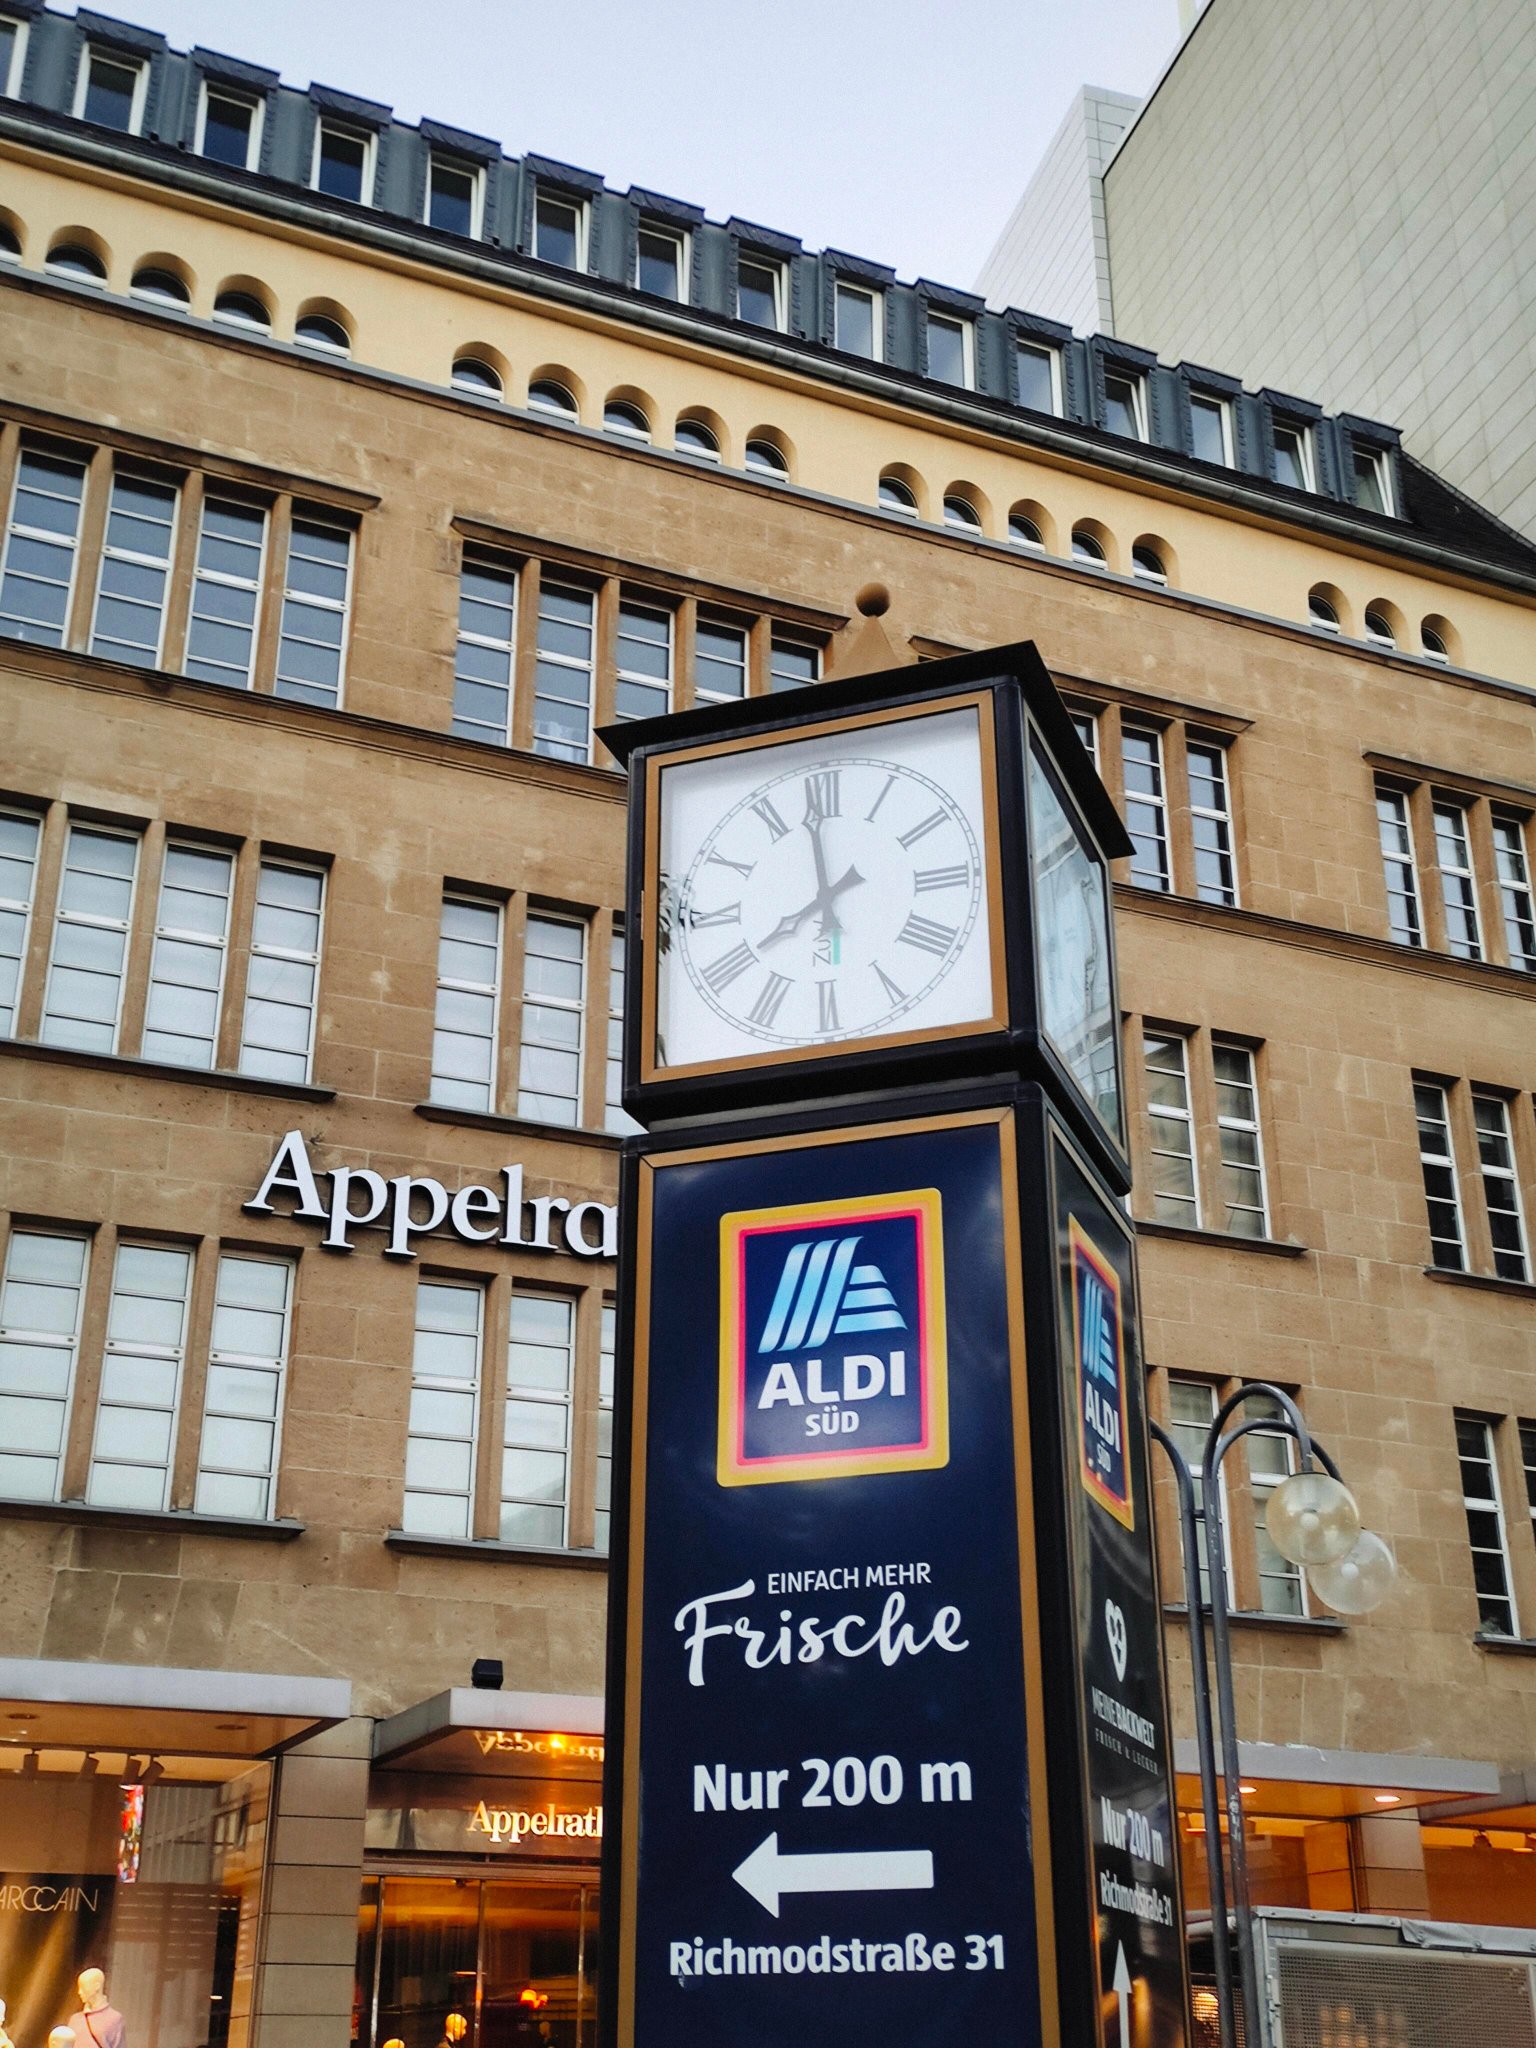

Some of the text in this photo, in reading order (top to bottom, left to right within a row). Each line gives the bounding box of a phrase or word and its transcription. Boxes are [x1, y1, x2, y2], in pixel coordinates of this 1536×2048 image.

[747, 793, 793, 844] XI
[896, 805, 951, 851] II
[704, 847, 758, 880] X
[913, 861, 970, 897] III
[699, 938, 760, 998] VIII
[868, 960, 911, 1010] V
[744, 970, 796, 1030] VII
[814, 979, 844, 1034] VI
[243, 1130, 618, 1258] Appelra
[757, 1350, 907, 1410] ALDI
[805, 1405, 860, 1437] SÜD
[1085, 1380, 1122, 1454] ALDI
[767, 1562, 932, 1595] EINFACH MEHR
[674, 1579, 970, 1687] Frische
[693, 1754, 973, 1813] Nur 200 m
[1101, 1795, 1165, 1867] Nur 200 m
[1100, 1869, 1173, 1927] Richmodstraße 31
[669, 1932, 1006, 1977] Richmodstraße 31
